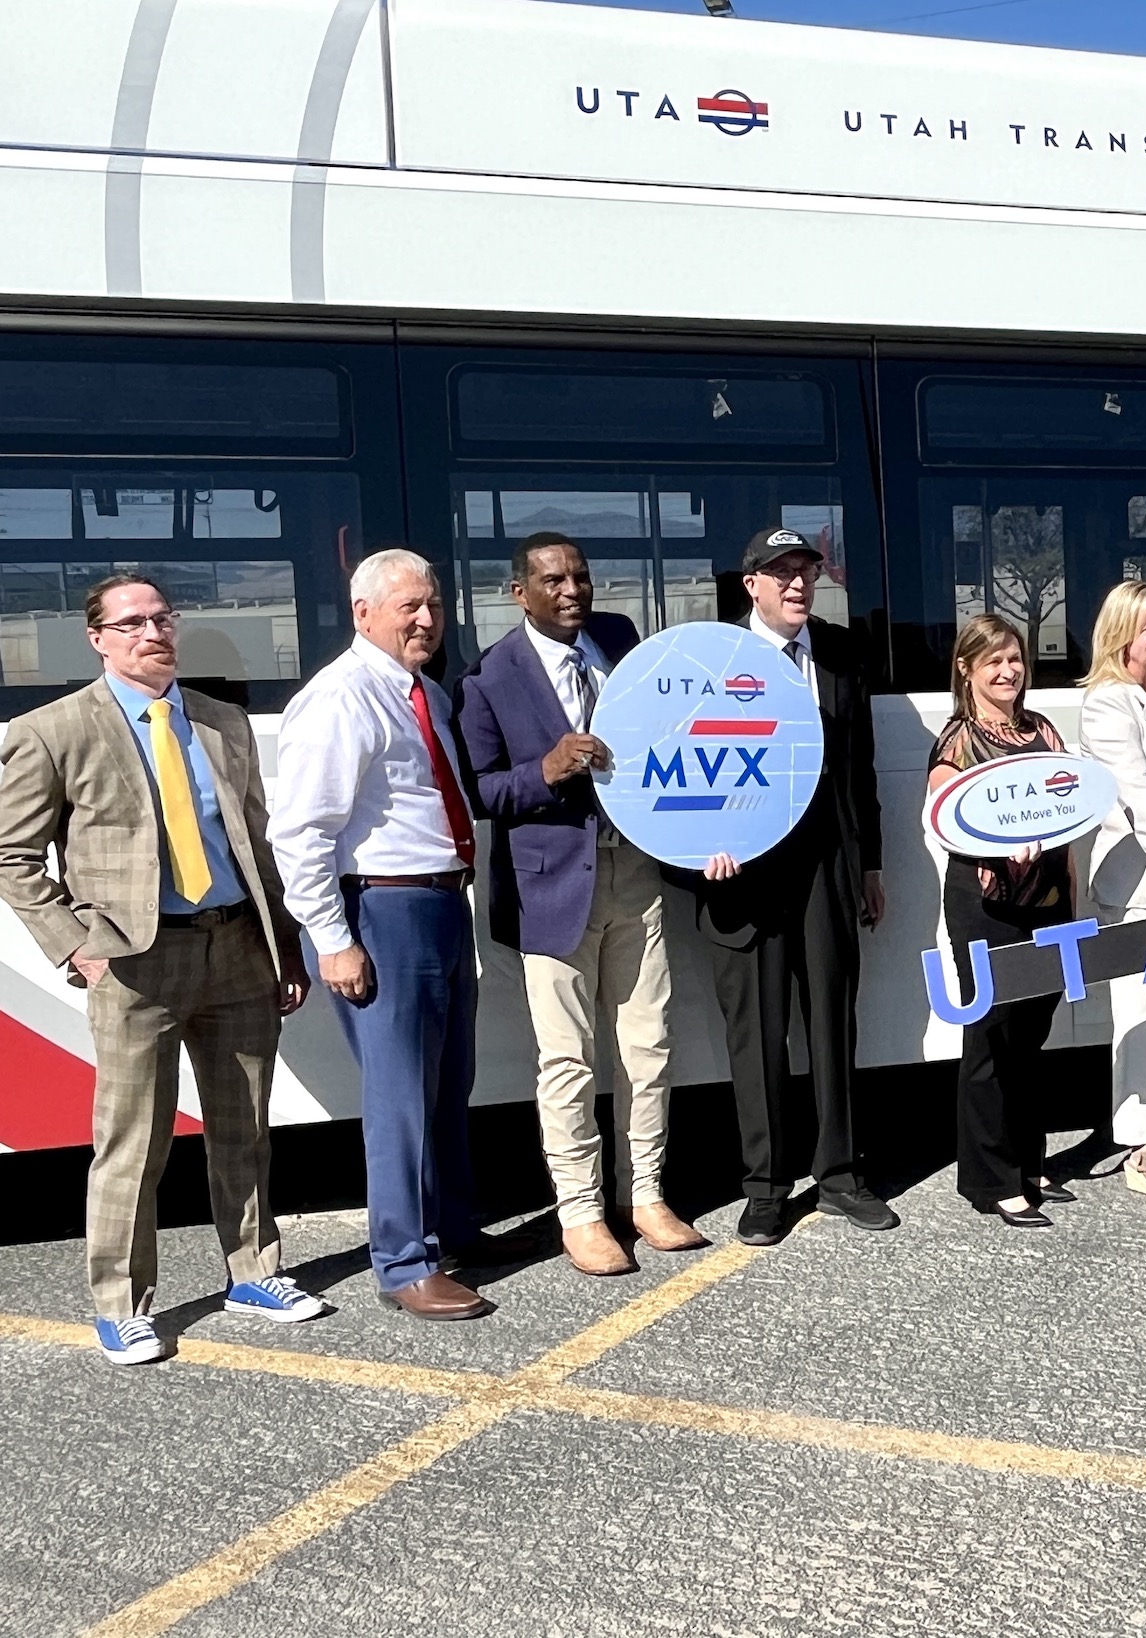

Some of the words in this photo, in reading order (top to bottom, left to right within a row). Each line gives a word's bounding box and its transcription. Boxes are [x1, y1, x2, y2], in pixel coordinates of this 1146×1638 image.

[575, 86, 680, 121] UTA
[843, 110, 968, 140] UTAH
[657, 678, 716, 696] UTA
[641, 746, 770, 788] MVX
[987, 782, 1038, 803] UTA
[997, 812, 1017, 826] We
[1020, 808, 1052, 822] Move
[1055, 803, 1076, 816] You
